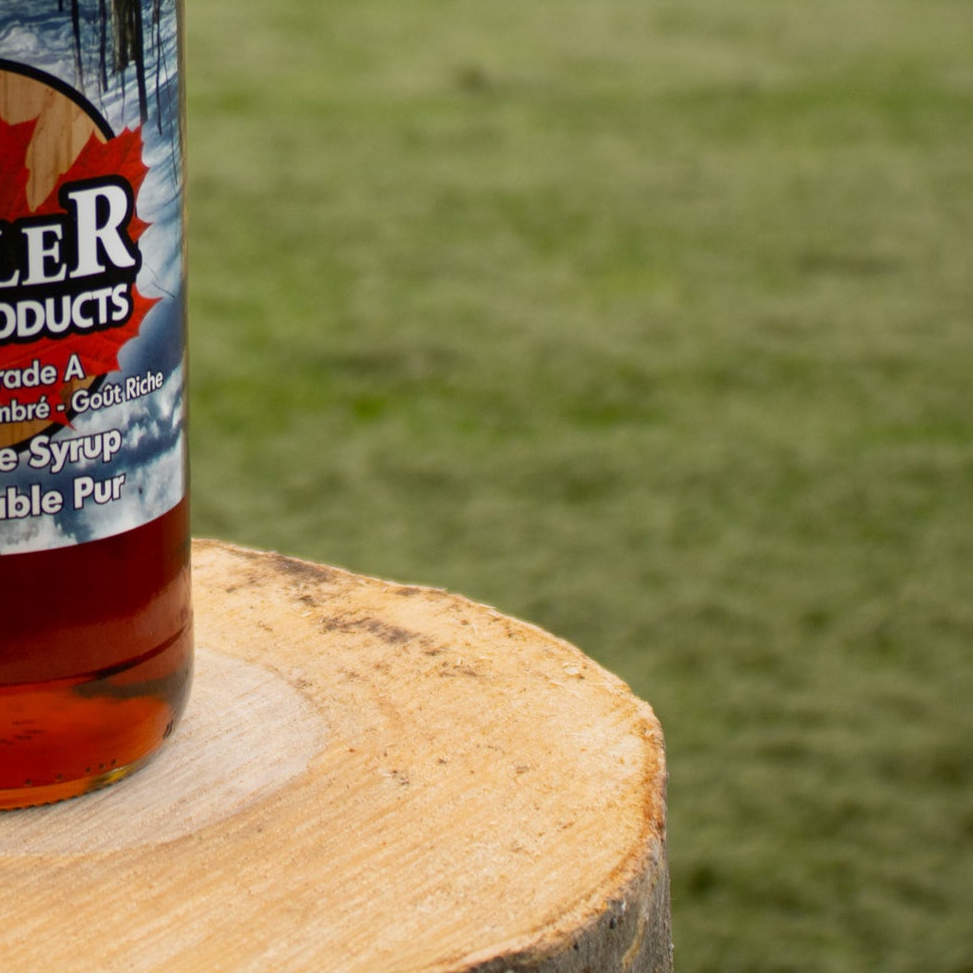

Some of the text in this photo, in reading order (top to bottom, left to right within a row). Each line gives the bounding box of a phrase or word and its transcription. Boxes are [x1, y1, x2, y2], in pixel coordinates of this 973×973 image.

[64, 354, 84, 380] A
[72, 384, 123, 414] Goût
[125, 371, 163, 402] Riche
[28, 429, 122, 473] Syrup
[74, 471, 126, 508] Pur
